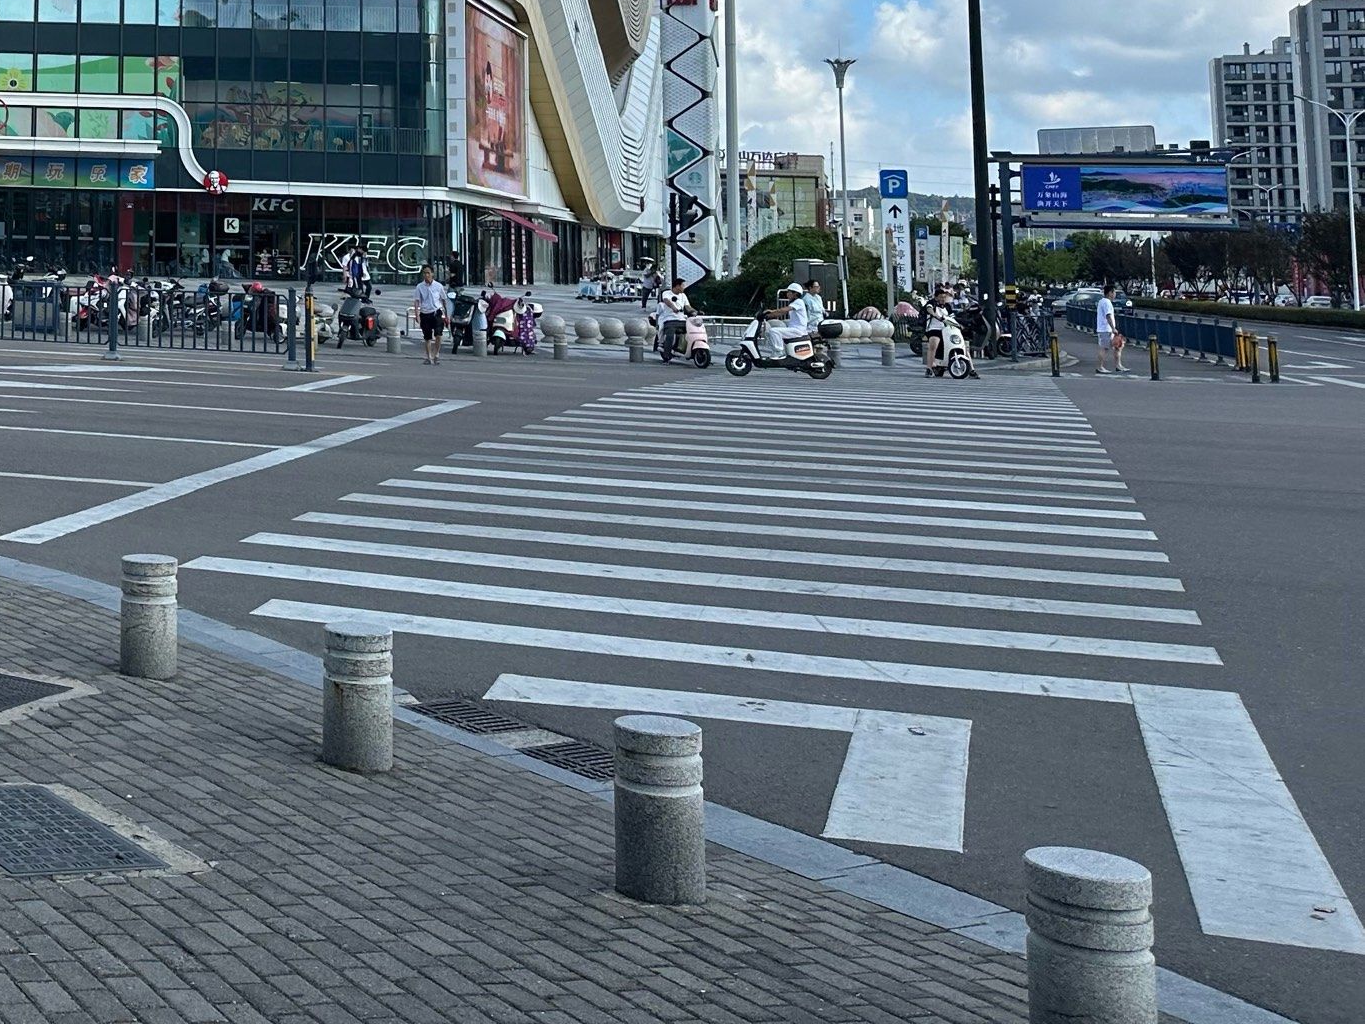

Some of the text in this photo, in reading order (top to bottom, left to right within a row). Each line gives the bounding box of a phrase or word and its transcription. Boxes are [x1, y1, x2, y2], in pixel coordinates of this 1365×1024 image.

[888, 179, 900, 193] P
[252, 197, 294, 212] KFC
[299, 233, 426, 274] KFC
